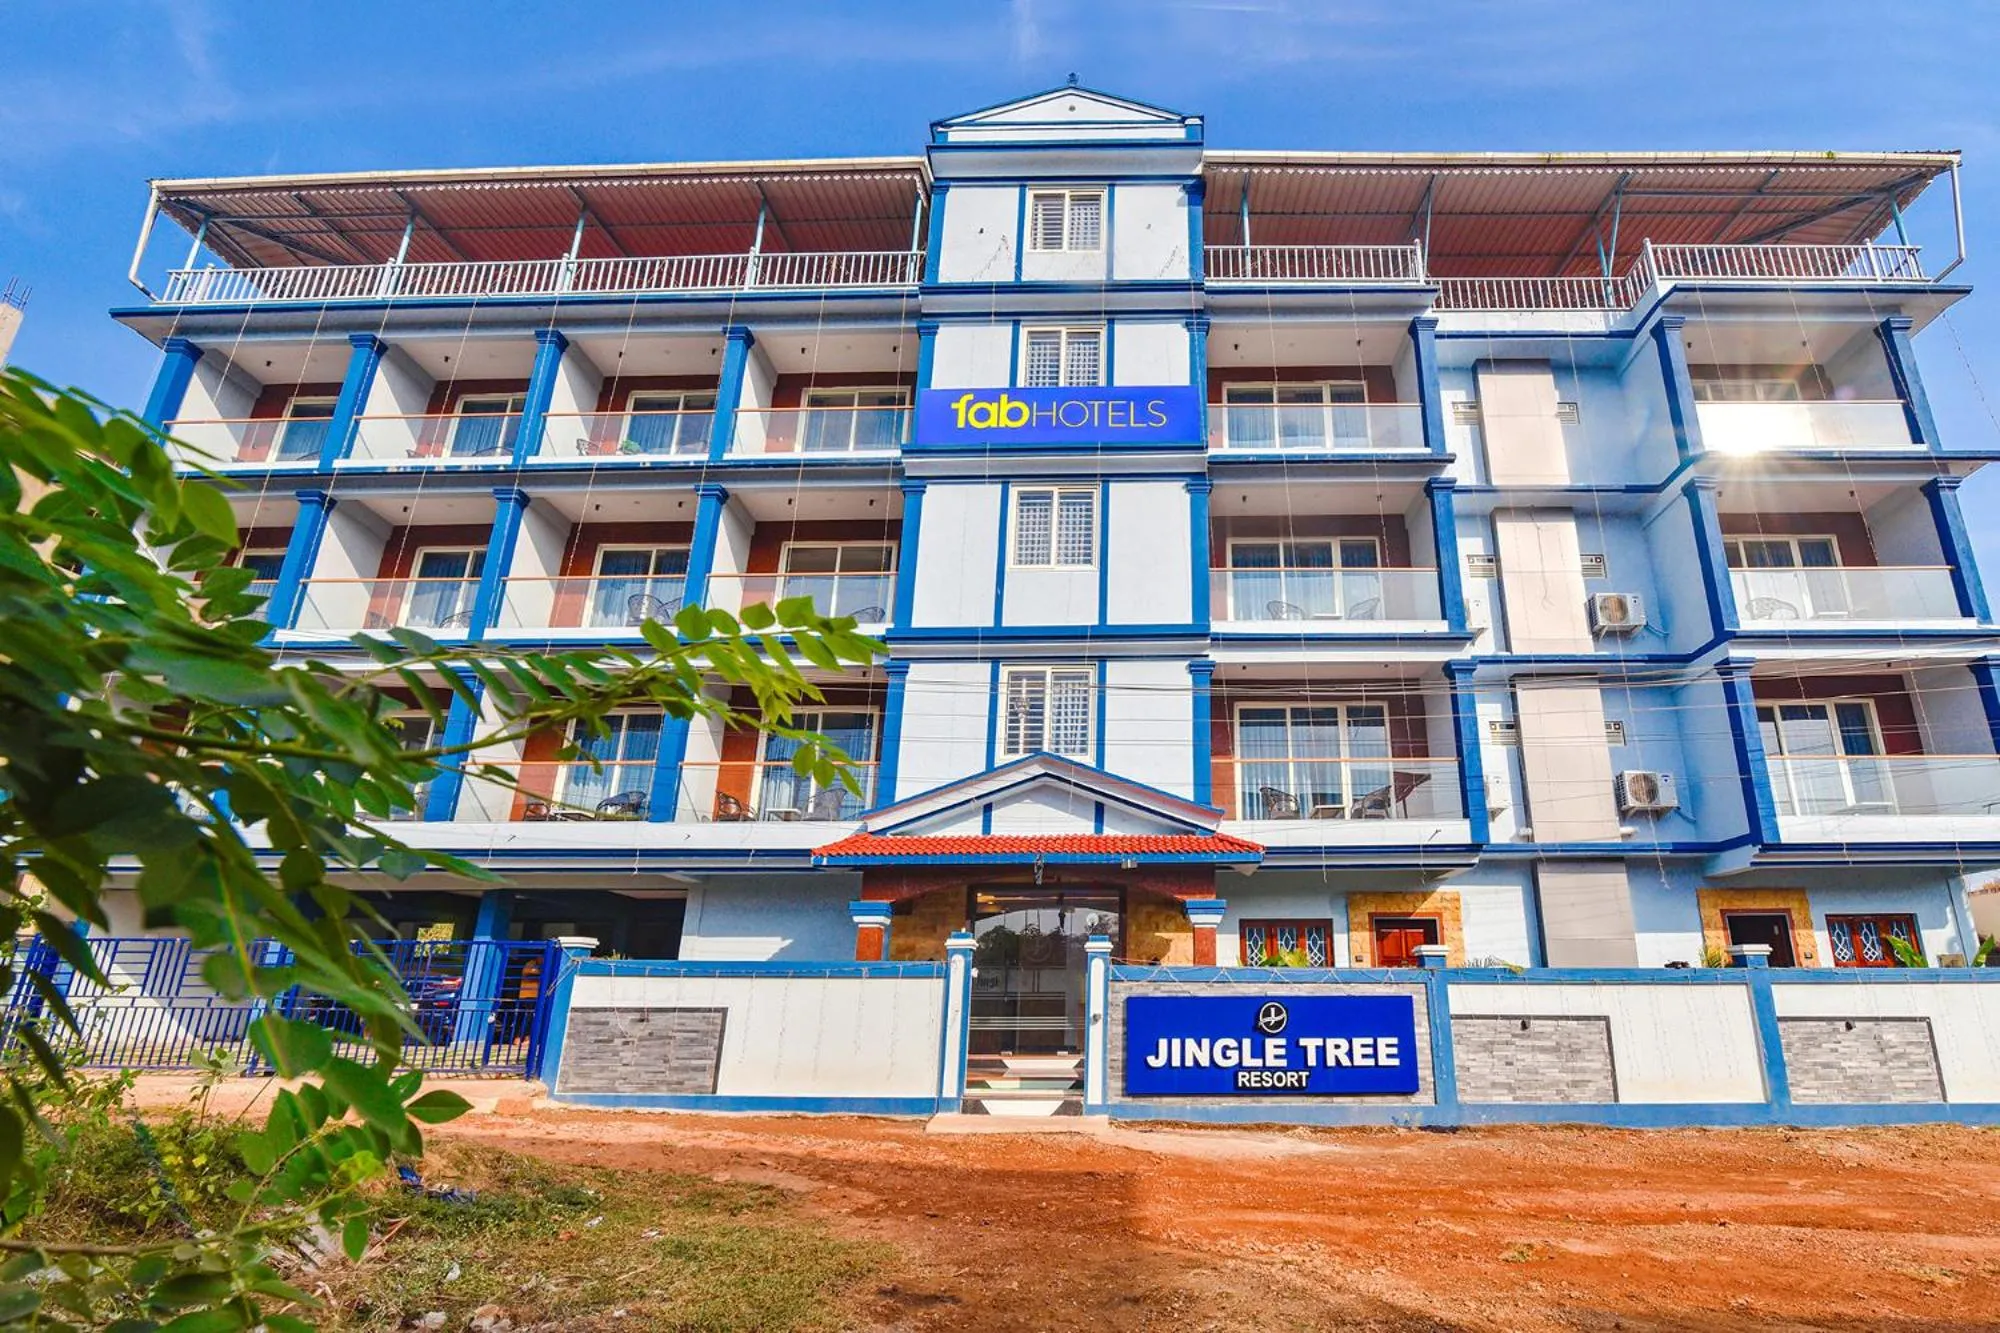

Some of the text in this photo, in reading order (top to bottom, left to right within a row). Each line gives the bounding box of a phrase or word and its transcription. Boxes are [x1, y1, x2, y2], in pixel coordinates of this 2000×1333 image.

[1146, 1037, 1400, 1067] JINGLE TREE
[1237, 1071, 1309, 1087] RESORT
